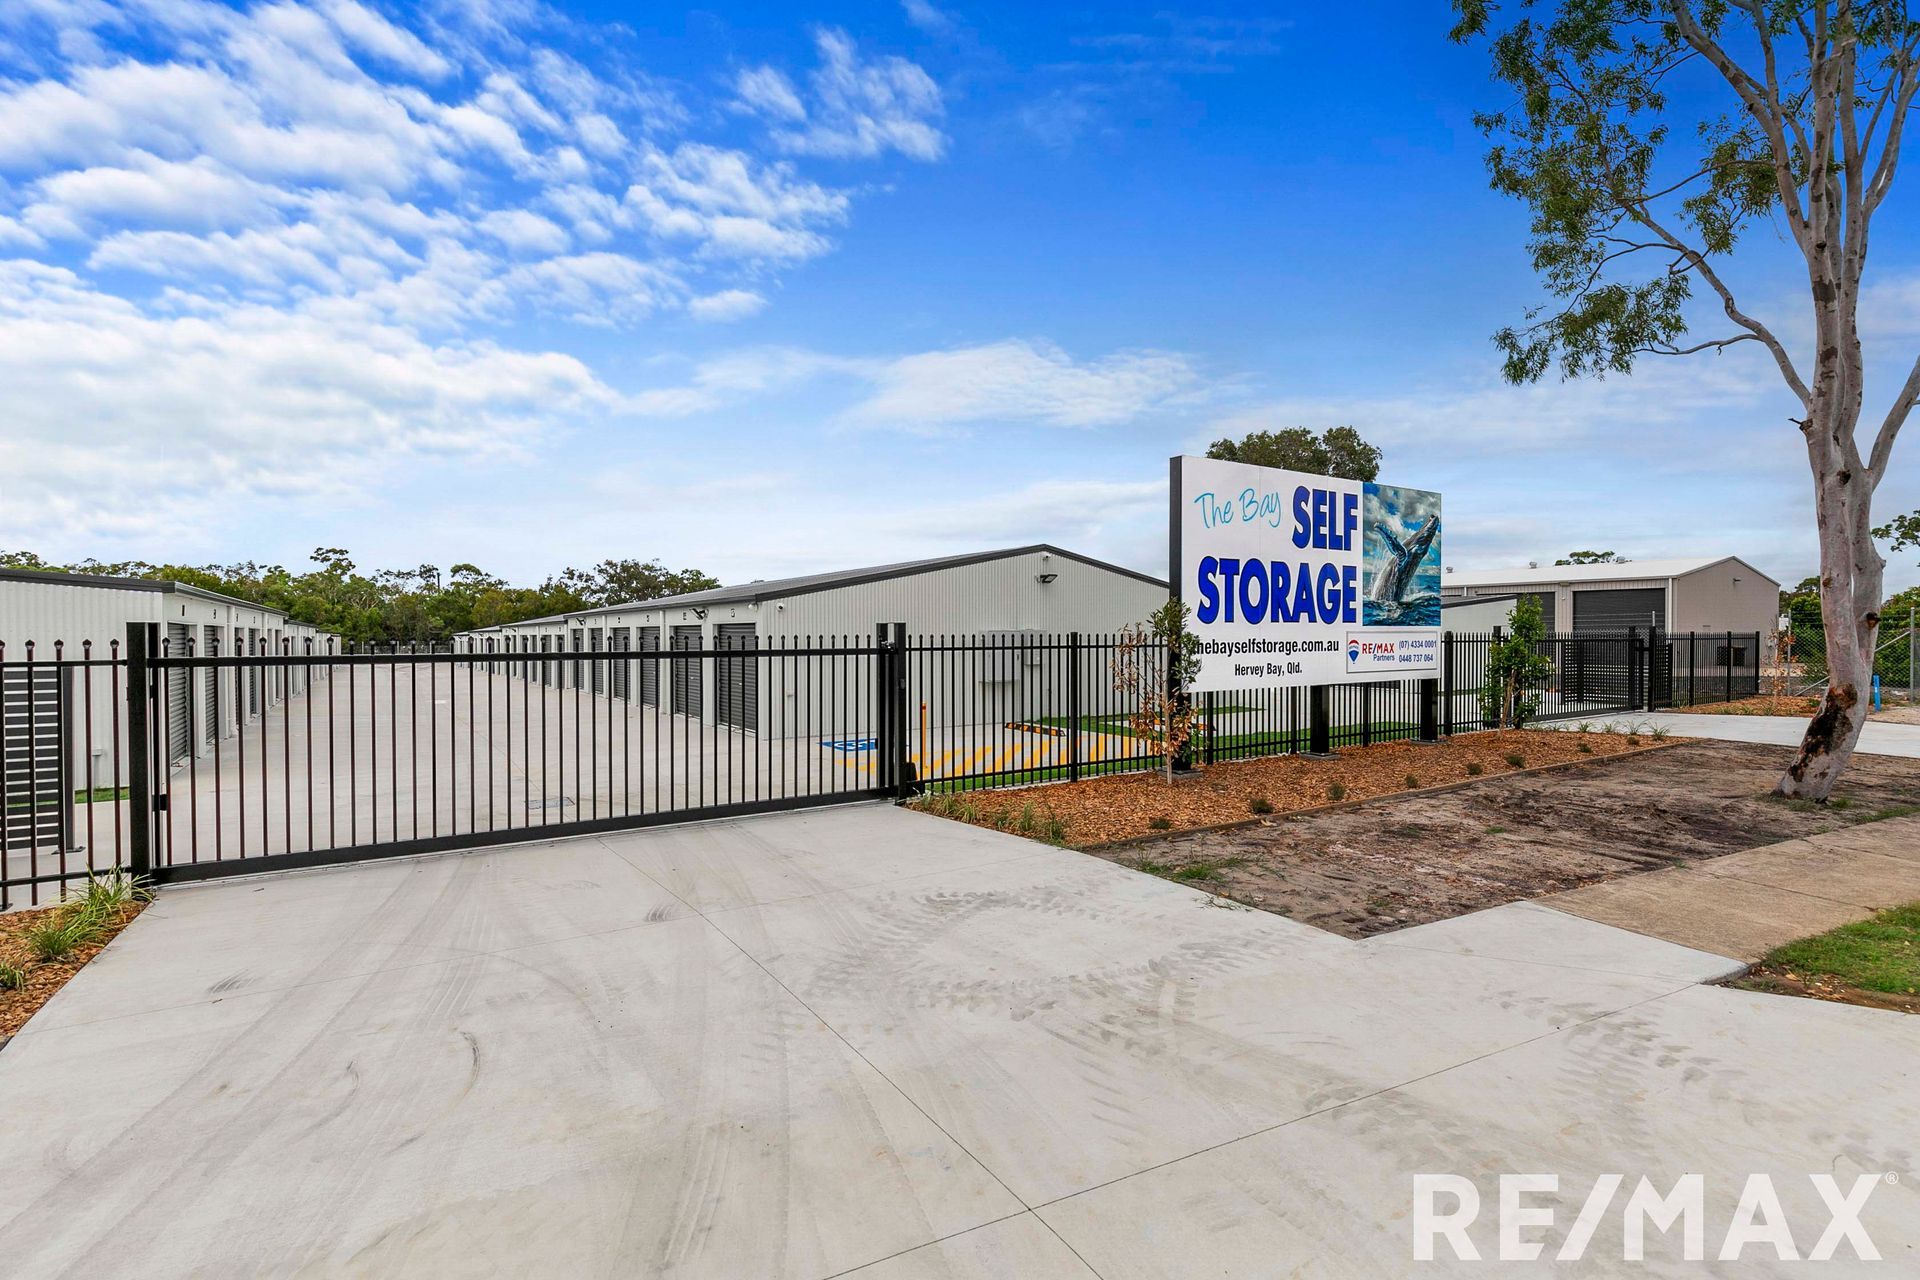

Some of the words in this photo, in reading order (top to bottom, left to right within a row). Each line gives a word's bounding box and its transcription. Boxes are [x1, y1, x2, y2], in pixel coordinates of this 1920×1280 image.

[1194, 492, 1234, 528] The
[1239, 488, 1281, 528] Bay
[1291, 485, 1358, 551] SELF
[1197, 555, 1357, 625] STORAGE
[1193, 638, 1339, 657] hebayselfstorage.com.au
[1362, 643, 1395, 654] RE/MAX
[1399, 640, 1409, 650] (07)
[1410, 640, 1423, 648] 4334
[1373, 654, 1395, 662] Partners
[1413, 654, 1423, 662] 737
[1234, 663, 1264, 678] Hervey
[1266, 662, 1285, 677] Bay,
[1287, 662, 1303, 674] Qld.
